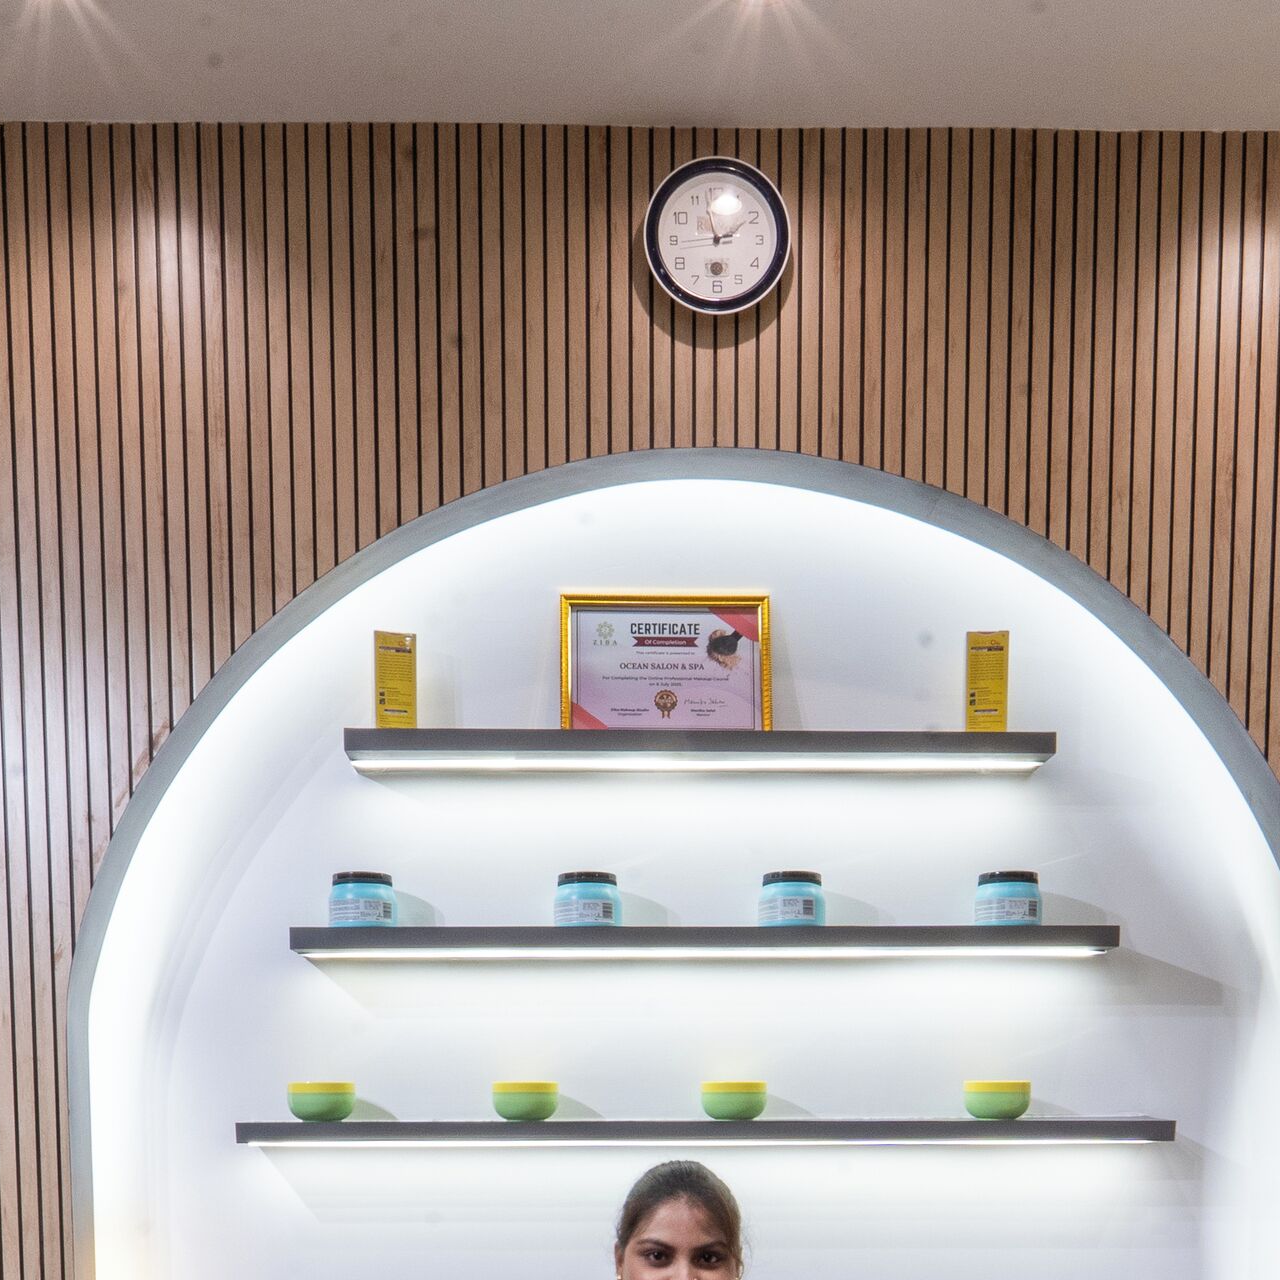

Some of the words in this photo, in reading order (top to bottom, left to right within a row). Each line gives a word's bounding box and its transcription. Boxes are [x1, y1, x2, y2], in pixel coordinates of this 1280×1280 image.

[690, 195, 700, 206] 11
[673, 211, 688, 225] 10
[748, 211, 760, 225] 2
[669, 235, 679, 246] 9
[755, 234, 765, 246] 3
[674, 256, 686, 270] 8
[749, 256, 760, 270] 4
[691, 274, 700, 286] 7
[734, 274, 744, 285] 5
[712, 280, 723, 294] 6
[630, 622, 701, 635] CERTIFICATE
[619, 662, 649, 670] OCEAN
[688, 663, 705, 671] SPA
